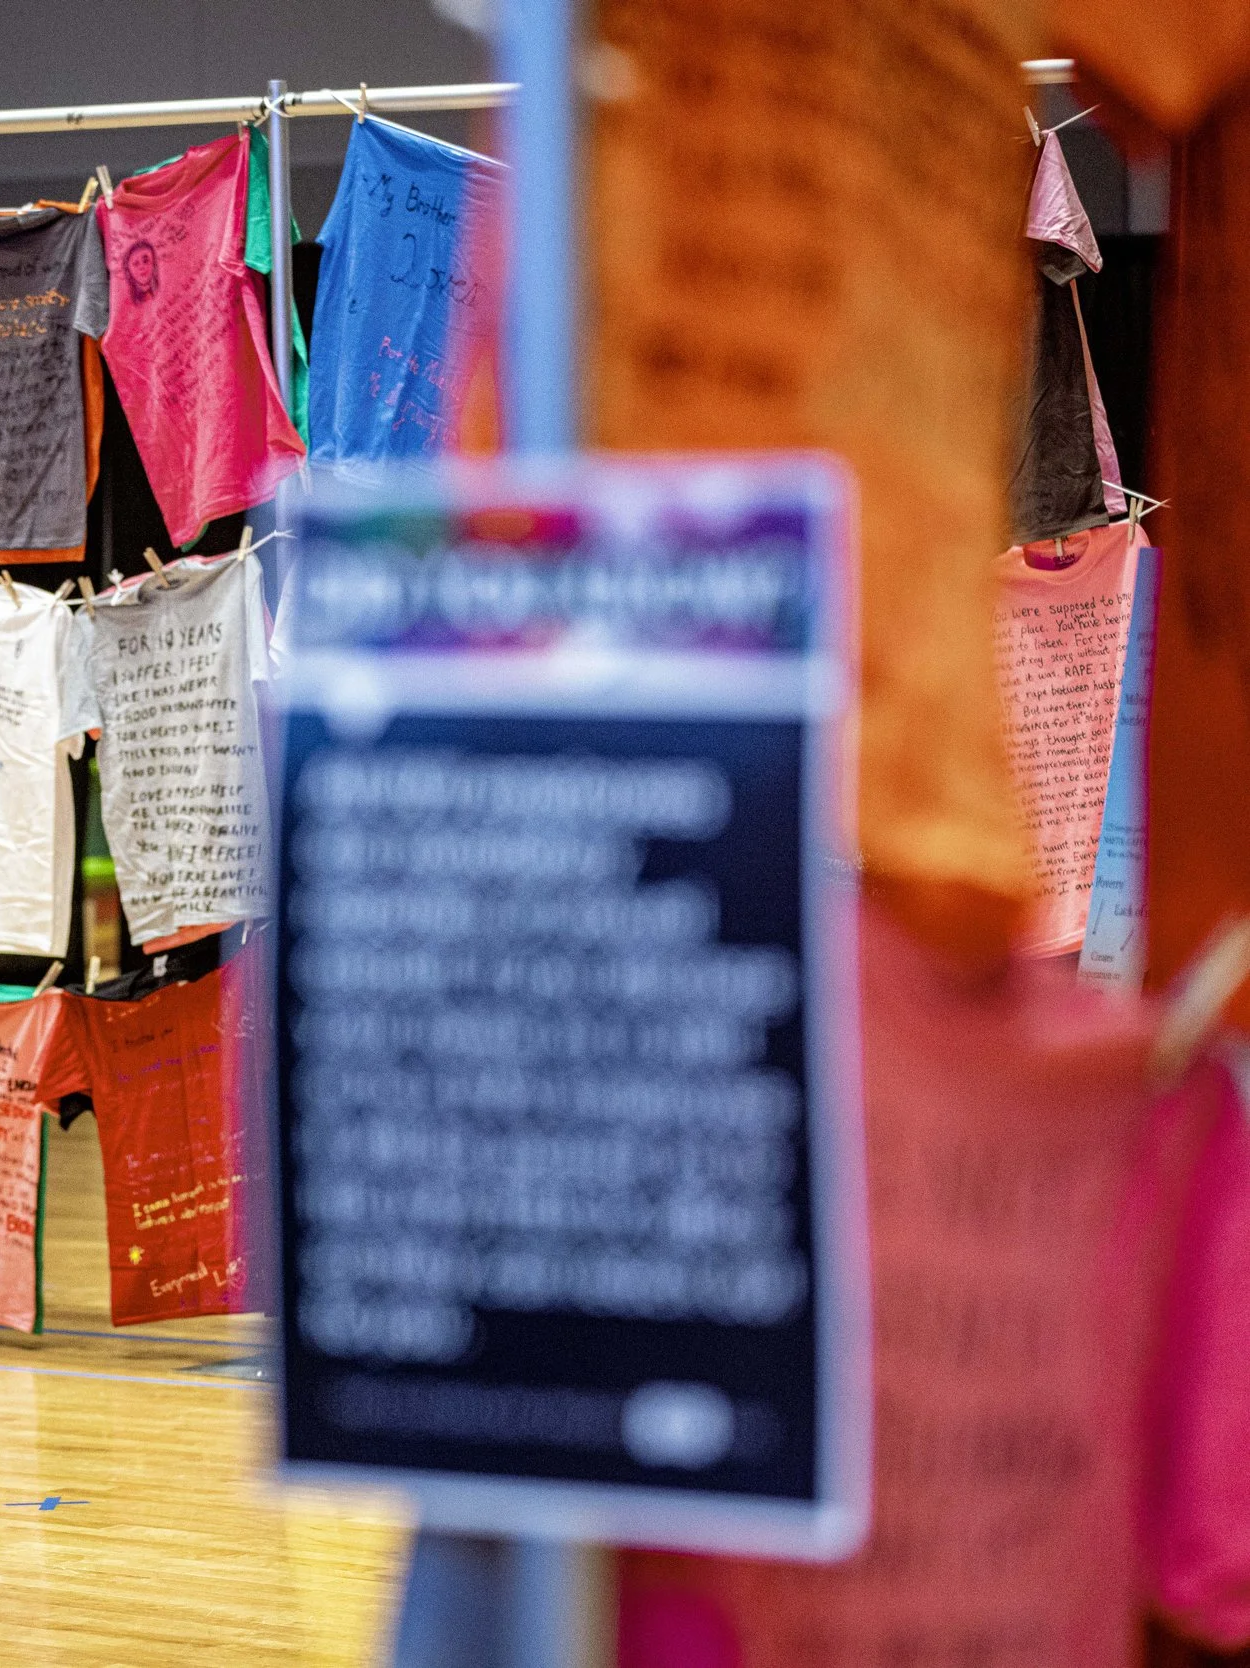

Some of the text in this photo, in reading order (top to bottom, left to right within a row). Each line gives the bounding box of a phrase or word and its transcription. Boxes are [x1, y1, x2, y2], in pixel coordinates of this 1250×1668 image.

[405, 180, 456, 226] Brother
[1048, 595, 1097, 619] supposed
[1100, 594, 1114, 607] to
[1020, 617, 1100, 638] place. You have
[118, 621, 223, 658] FOR 10 YEARS
[1034, 637, 1068, 651] listen.
[1074, 632, 1093, 647] For
[189, 652, 218, 674] FELT
[1050, 651, 1074, 663] story
[1077, 645, 1111, 658] without
[152, 683, 176, 699] WAS
[179, 675, 220, 693] NEVER
[1025, 683, 1091, 701] rape between
[1043, 703, 1066, 715] when
[1065, 697, 1100, 712] there's
[1046, 730, 1087, 747] thought
[1091, 727, 1109, 741] you
[1045, 745, 1084, 757] moment.
[1053, 768, 1109, 783] to be excru
[130, 788, 162, 804] LOVE
[1042, 839, 1070, 854] haunt
[1058, 880, 1069, 896] I
